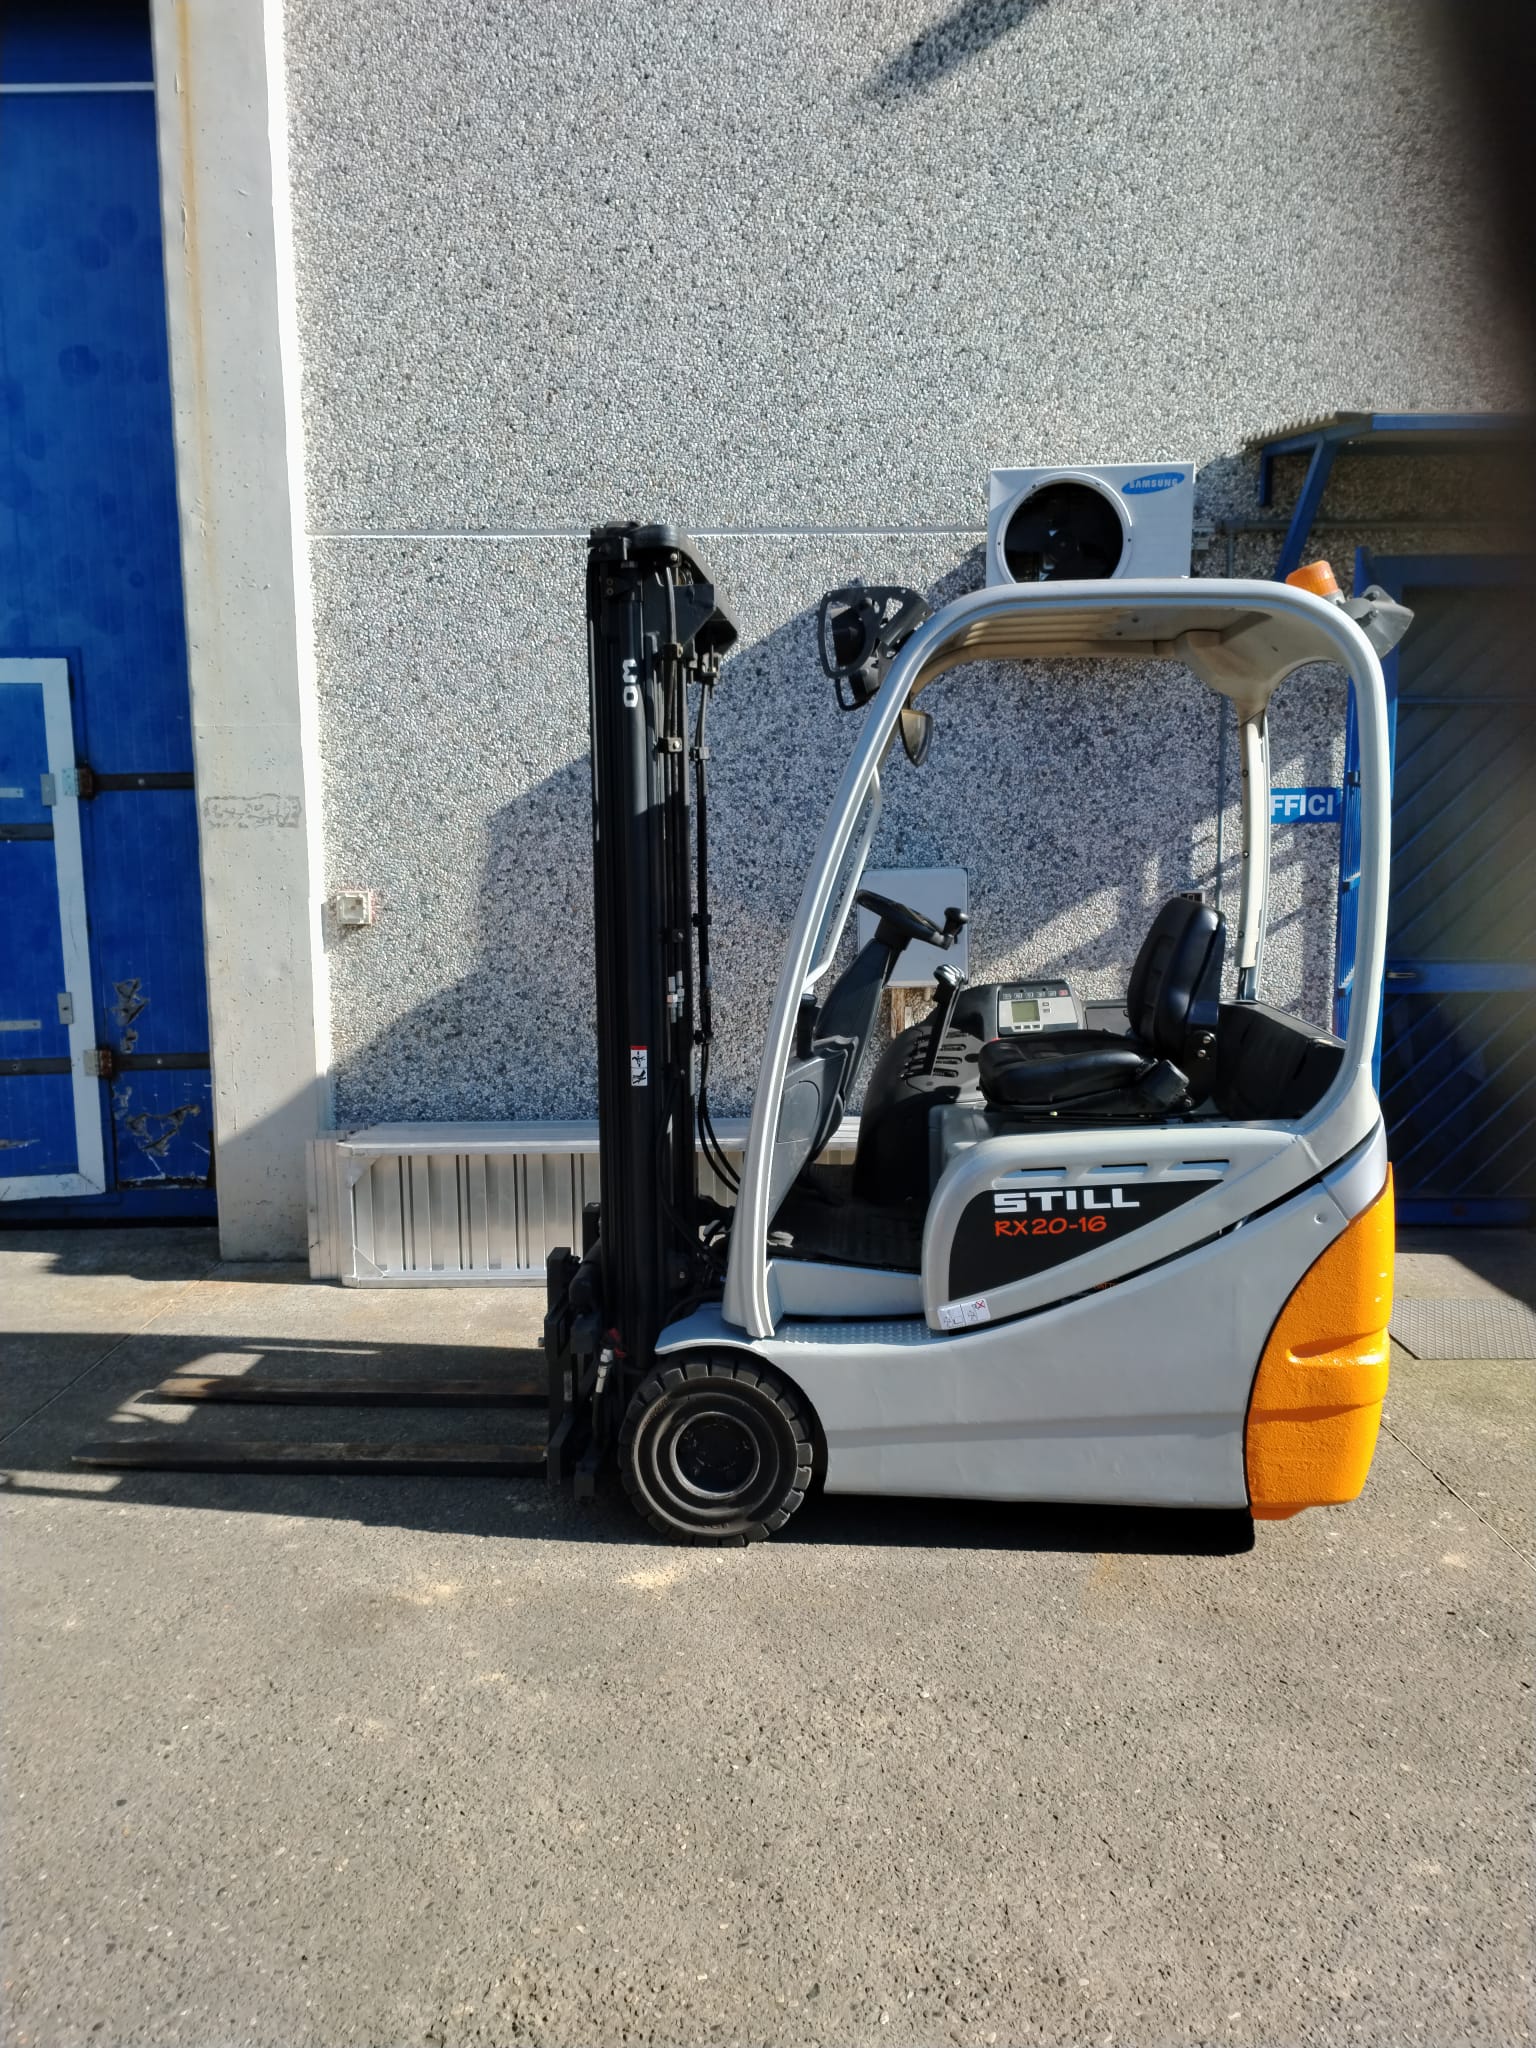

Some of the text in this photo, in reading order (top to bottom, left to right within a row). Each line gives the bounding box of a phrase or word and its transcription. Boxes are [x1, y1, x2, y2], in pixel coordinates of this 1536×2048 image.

[1129, 478, 1178, 489] SAMSUNG
[1271, 794, 1334, 816] FFICI
[994, 1188, 1140, 1214] STILL
[994, 1215, 1107, 1237] RX20-16
